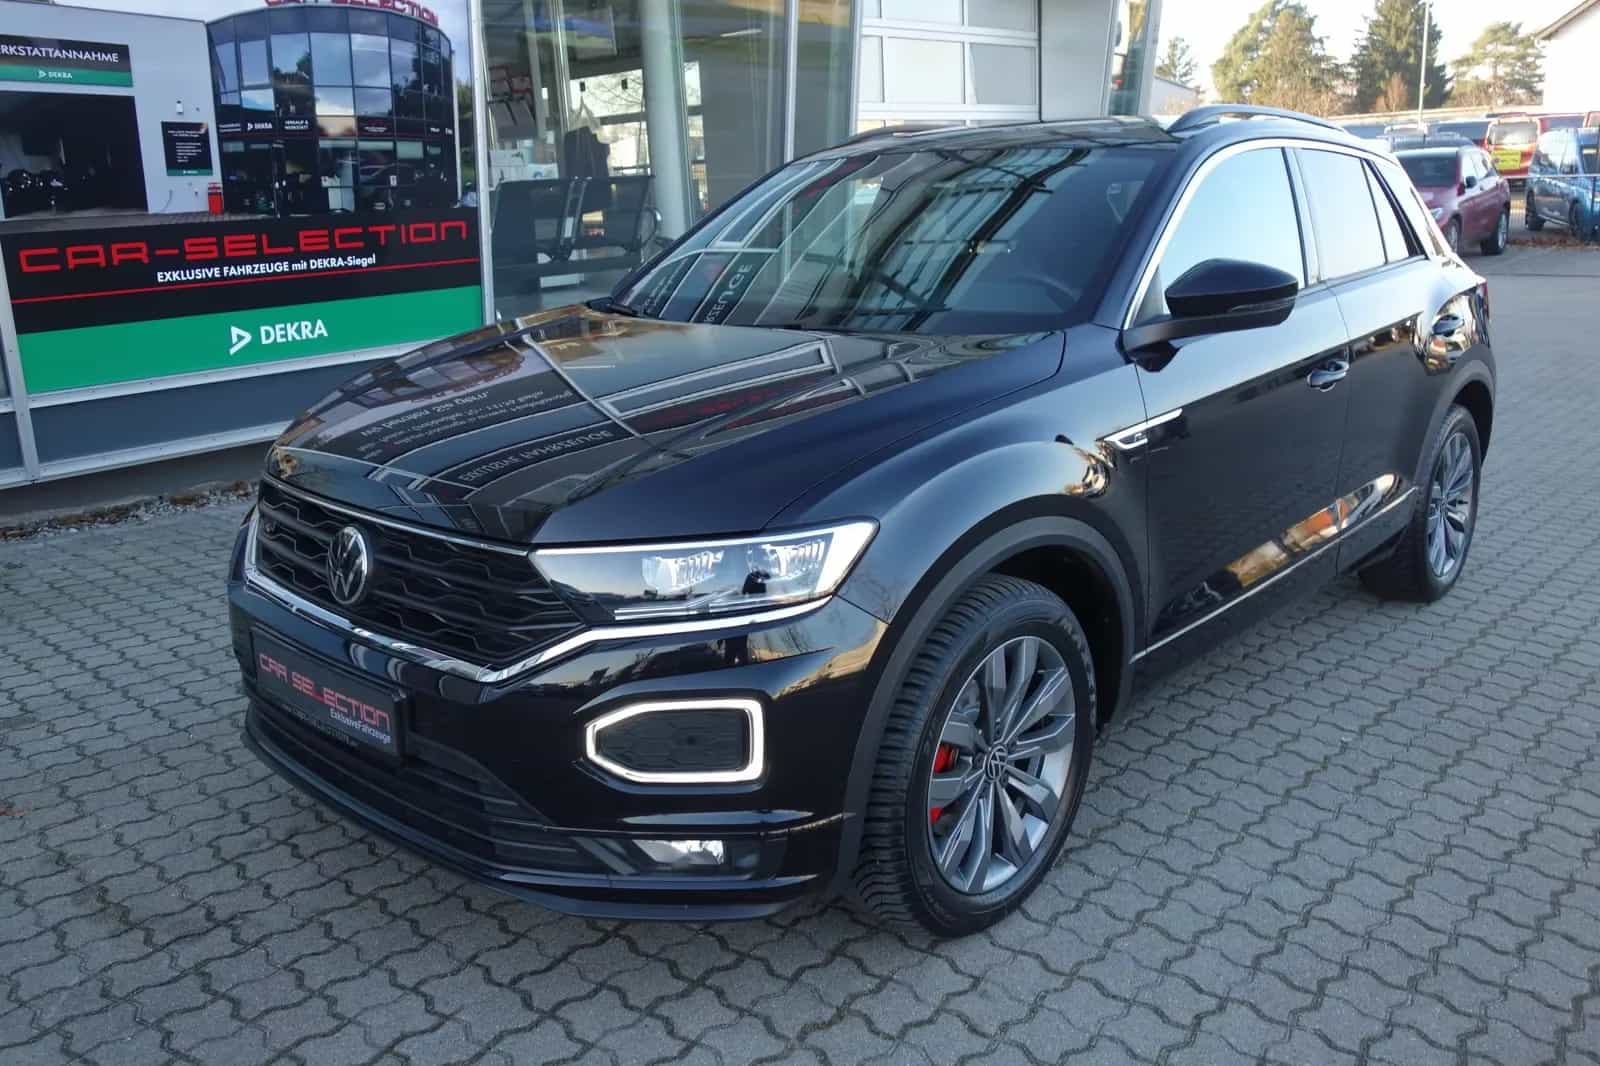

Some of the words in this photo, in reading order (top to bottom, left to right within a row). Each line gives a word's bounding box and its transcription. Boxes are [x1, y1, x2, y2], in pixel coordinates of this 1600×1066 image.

[19, 221, 467, 273] CAR-SELECTION
[157, 266, 221, 283] EXKLUSIVE
[223, 261, 290, 277] FAHRZEUGE
[291, 259, 308, 272] mit
[309, 253, 377, 270] DEKRA-Siegel
[260, 319, 329, 345] DEKRA
[259, 653, 288, 684] CAR
[292, 671, 391, 732] SELECTION
